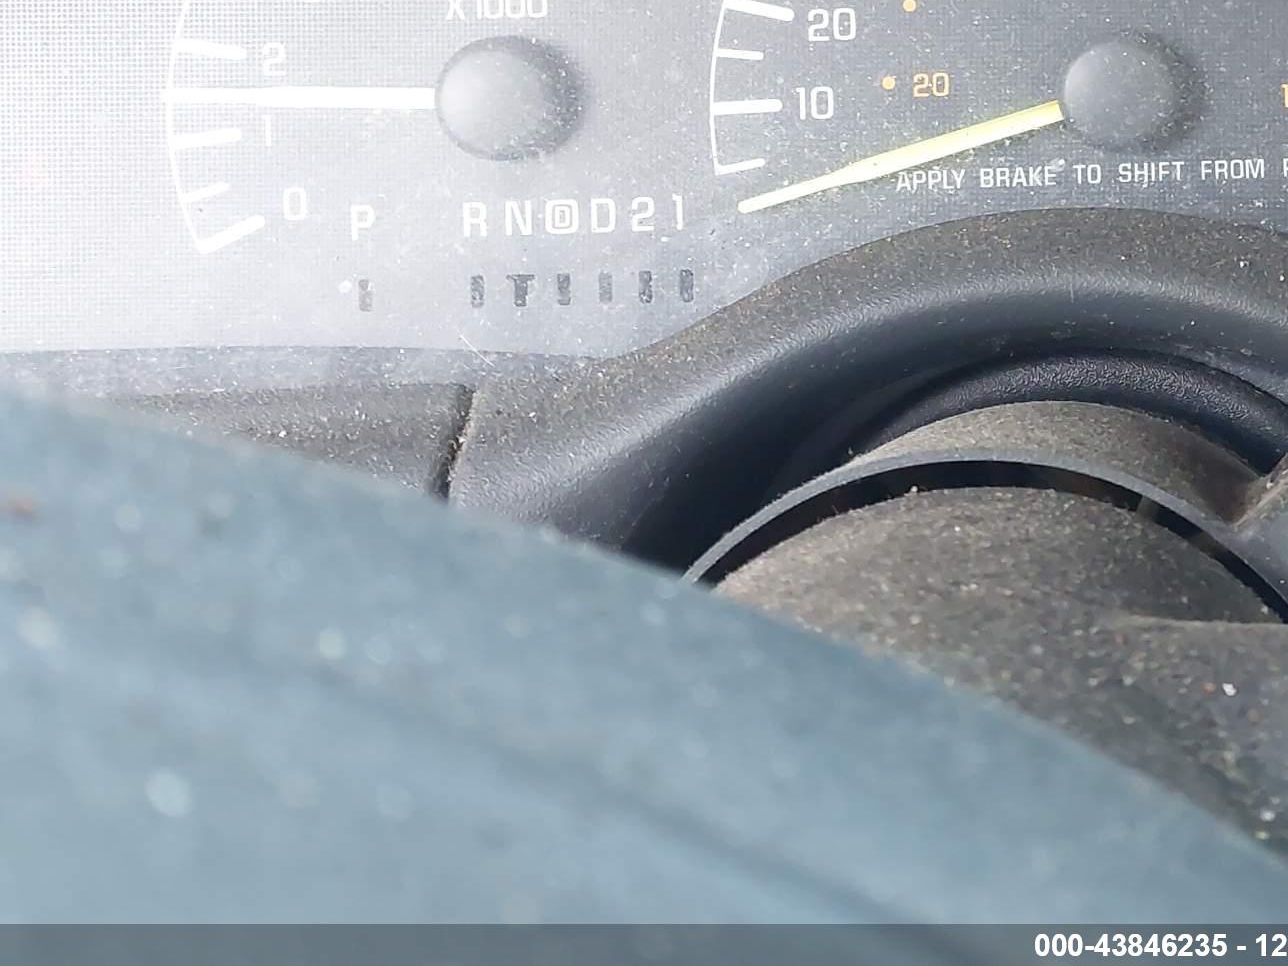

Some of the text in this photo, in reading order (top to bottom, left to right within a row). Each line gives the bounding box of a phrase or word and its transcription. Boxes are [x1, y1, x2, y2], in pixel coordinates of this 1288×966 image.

[808, 8, 856, 41] 20
[260, 42, 286, 76] 2
[913, 73, 949, 97] 20
[796, 87, 833, 119] 10
[262, 116, 273, 147] 1
[896, 168, 966, 193] APPLY
[980, 165, 1057, 188] BRAKE
[1073, 164, 1101, 184] TO
[1119, 161, 1185, 183] SHIFT
[1201, 159, 1264, 179] FROM
[283, 186, 308, 220] 0
[350, 205, 375, 240] P
